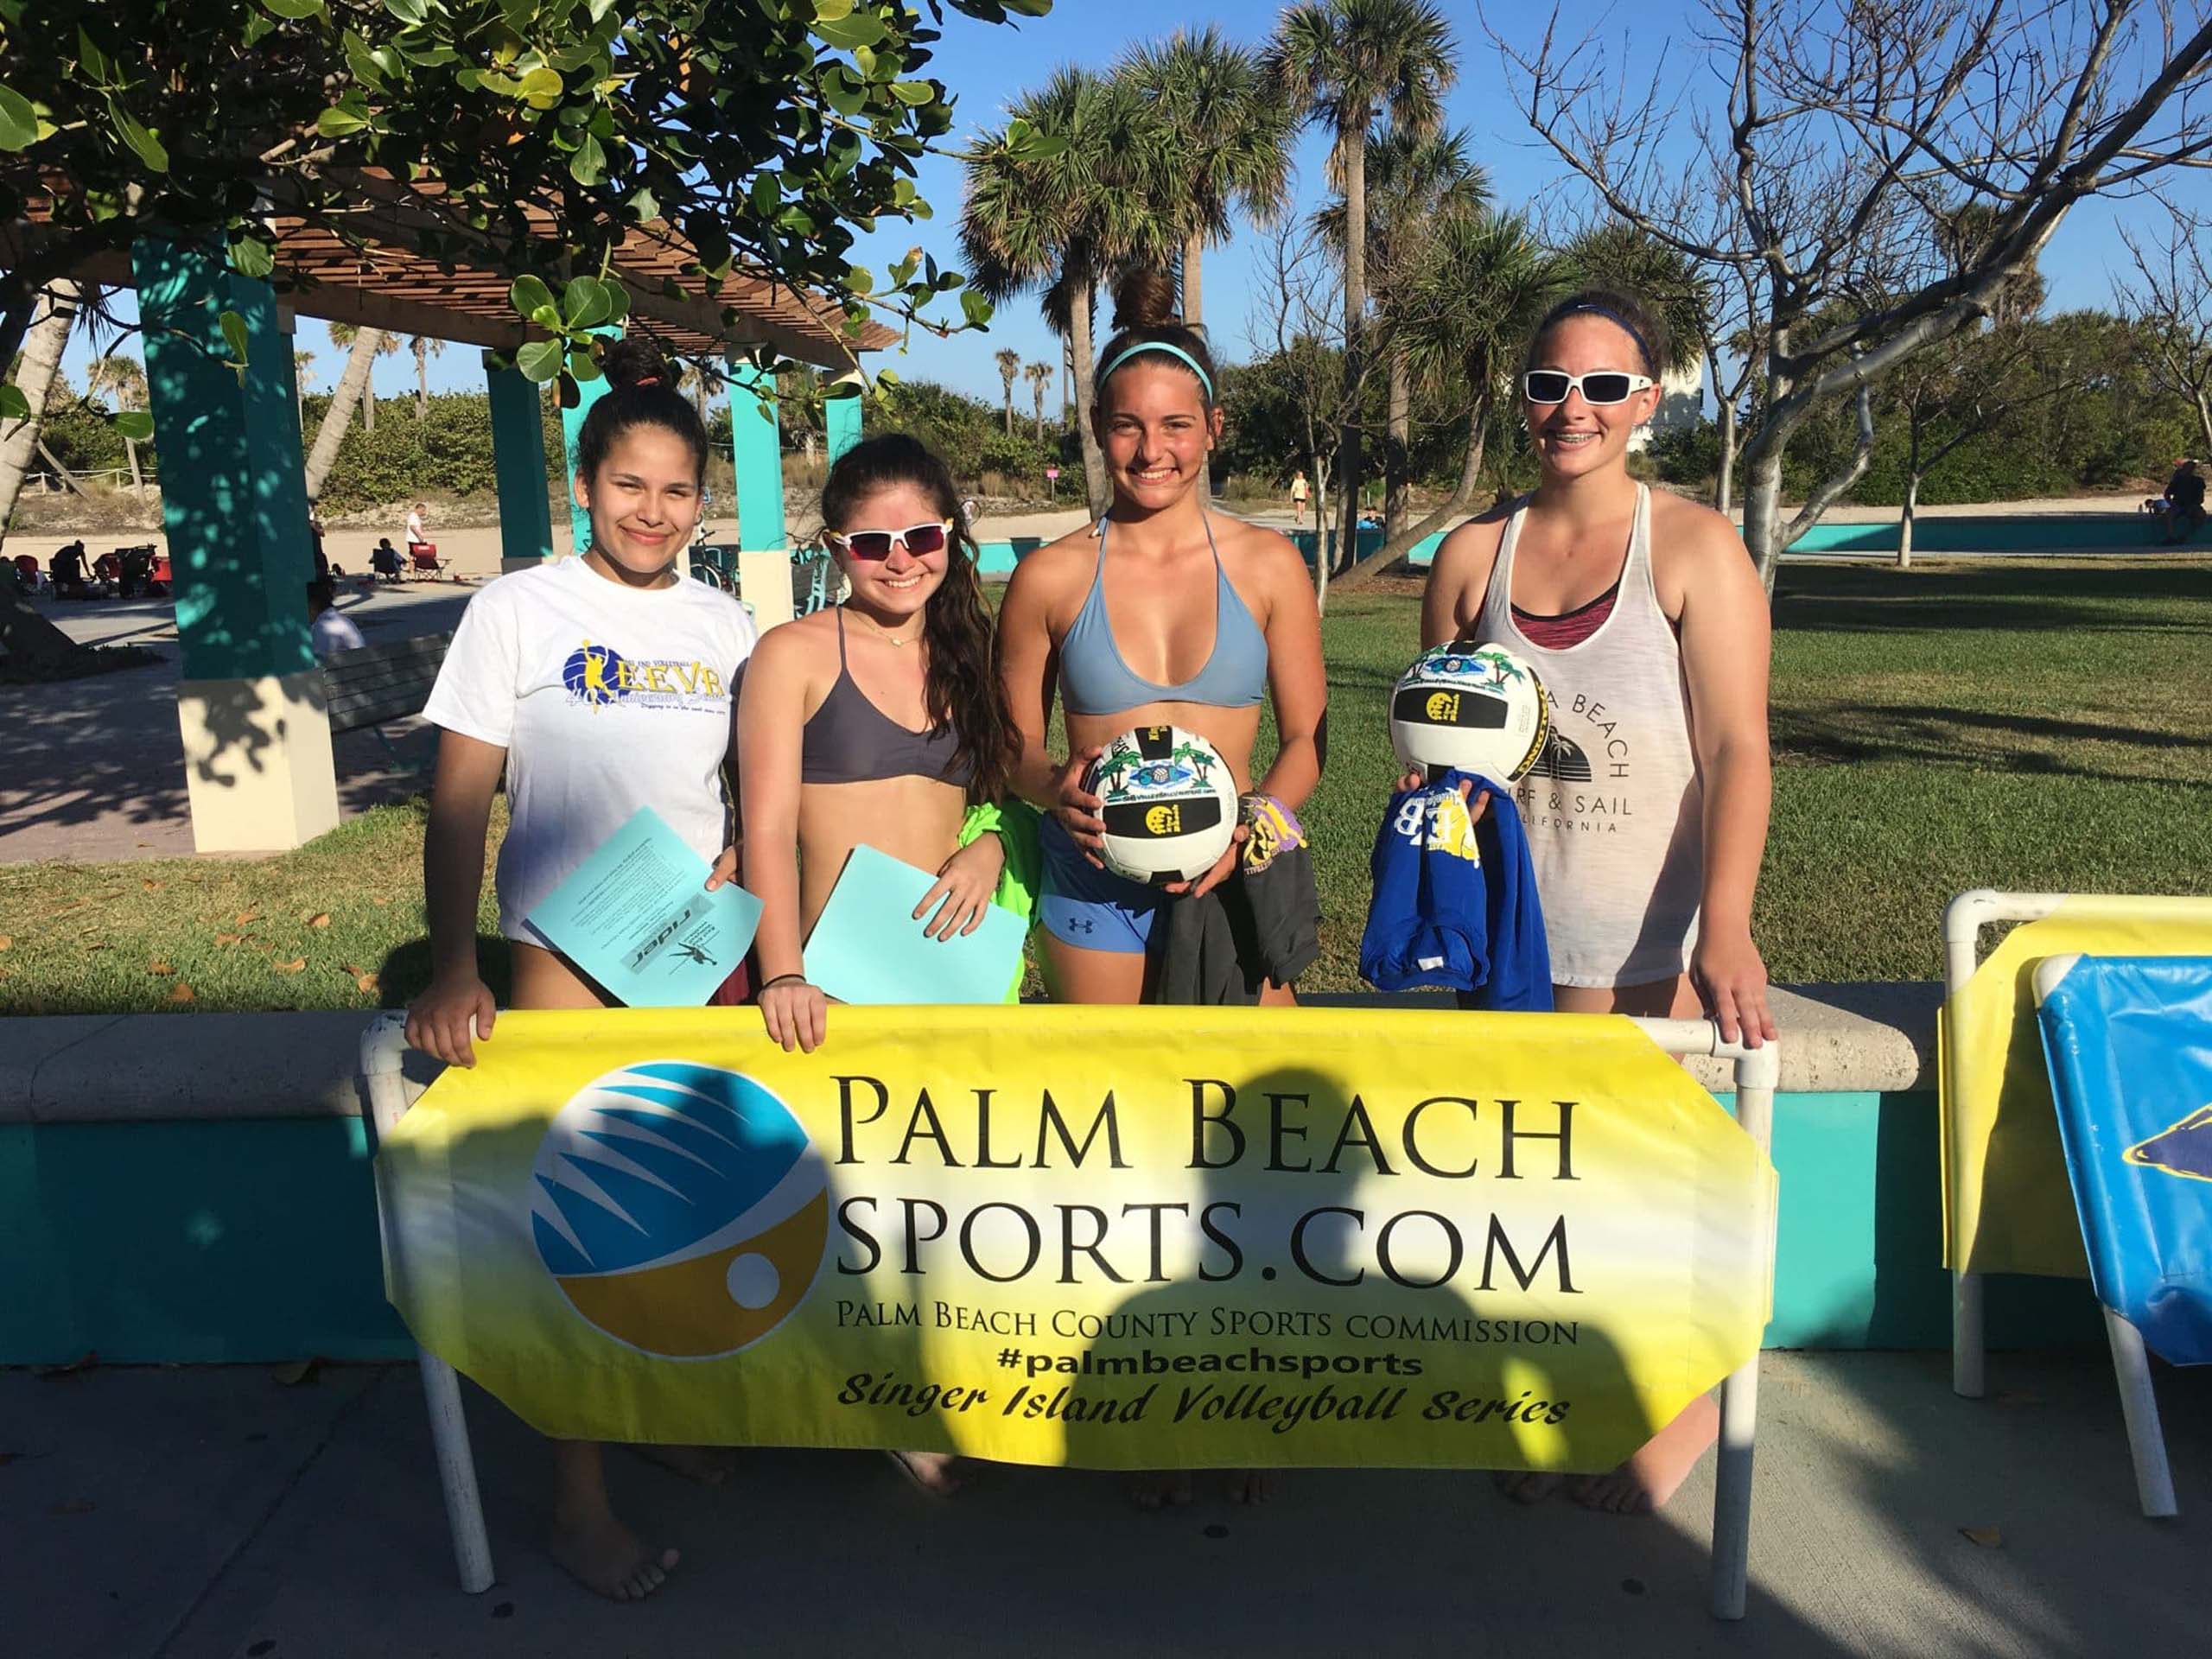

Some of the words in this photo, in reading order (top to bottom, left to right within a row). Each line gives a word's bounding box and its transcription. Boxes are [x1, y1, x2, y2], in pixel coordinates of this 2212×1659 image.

[1572, 694, 1630, 778] BEACH
[1522, 814, 1617, 832] LIFORNIA
[1548, 792, 1561, 810] &
[1574, 796, 1632, 816] SAIL
[630, 909, 691, 969] rider
[830, 1076, 1134, 1169] PALM
[1183, 1078, 1581, 1180] BEACH
[836, 1196, 1583, 1294] SPORTS.COM
[836, 1301, 923, 1328] PALM
[934, 1301, 1037, 1337] BEACH
[1052, 1309, 1198, 1339] COUNTY
[1211, 1306, 1332, 1337] SPORTS
[1346, 1315, 1580, 1344] COMMISSION
[996, 1348, 1423, 1379] #palmbeachsports
[837, 1372, 991, 1417] Singer
[1001, 1382, 1160, 1424] Island
[1172, 1383, 1408, 1434] Volleyball
[1421, 1390, 1571, 1425] Series
